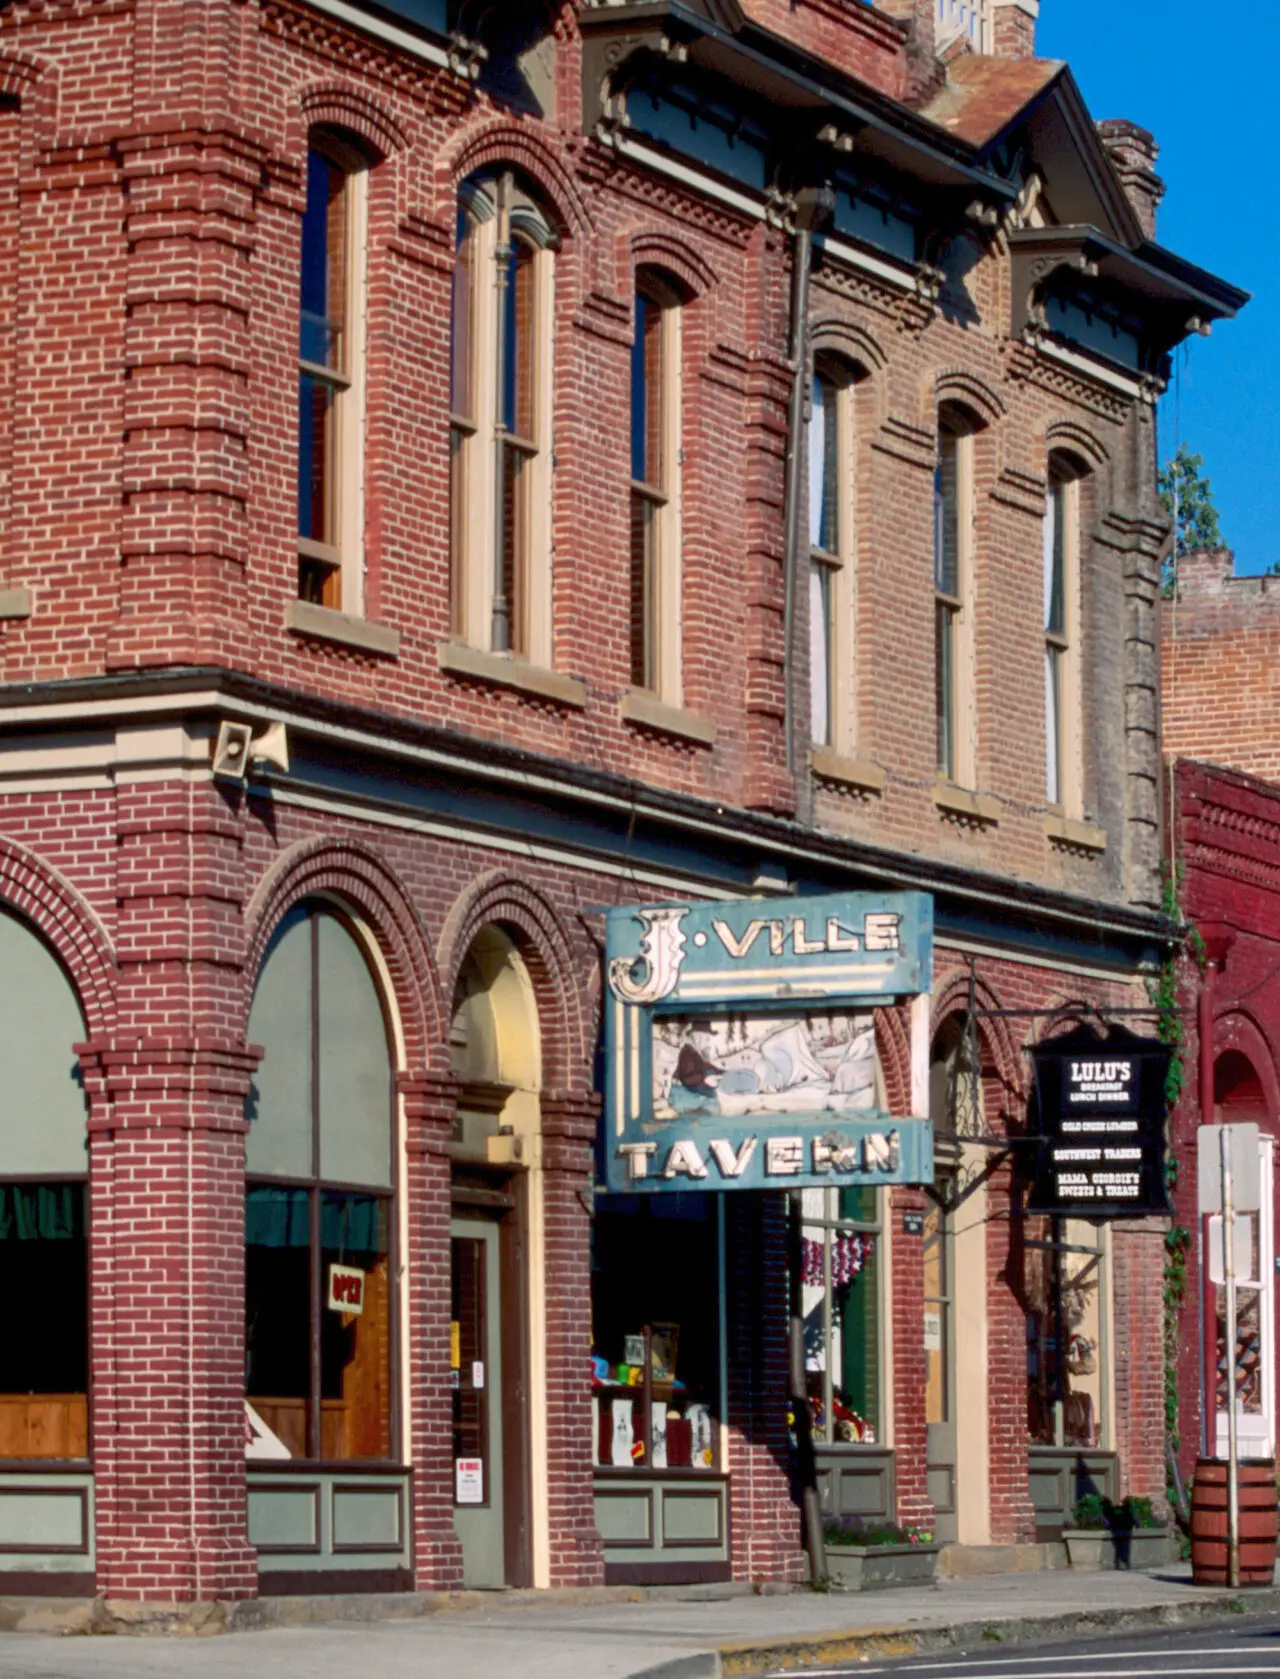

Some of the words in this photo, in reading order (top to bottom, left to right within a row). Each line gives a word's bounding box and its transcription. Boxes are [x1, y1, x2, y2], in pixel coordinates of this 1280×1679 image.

[1071, 1062, 1131, 1081] LULU'S
[615, 1128, 902, 1181] TAVERN
[1057, 1173, 1088, 1184] MAMA
[332, 1272, 363, 1305] OPEN
